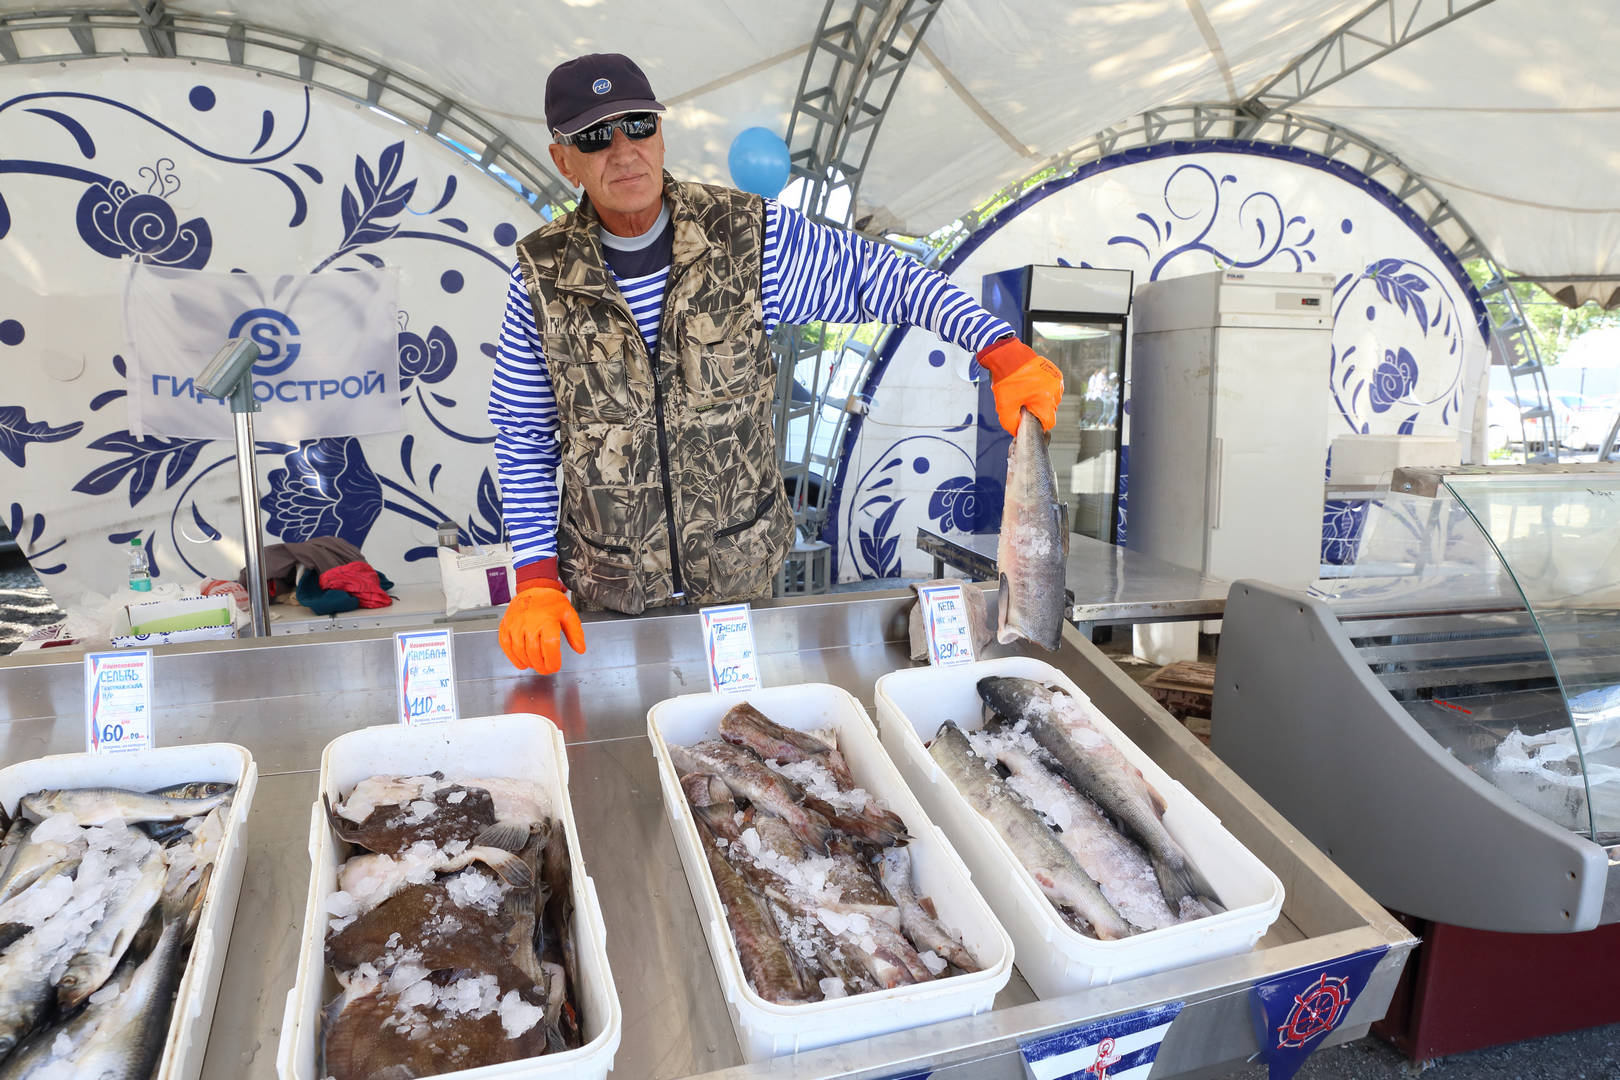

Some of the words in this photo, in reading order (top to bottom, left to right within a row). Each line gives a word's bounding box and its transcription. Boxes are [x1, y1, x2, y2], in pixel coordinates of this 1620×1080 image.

[152, 371, 385, 405] ГИОСТРОЙ
[712, 623, 747, 634] ТРЕСКА
[407, 649, 446, 661] КАМБАЛА
[100, 669, 139, 682] СЕЛЬДЬ
[719, 666, 738, 683] 155
[411, 696, 433, 713] 110
[103, 724, 123, 741] 60
